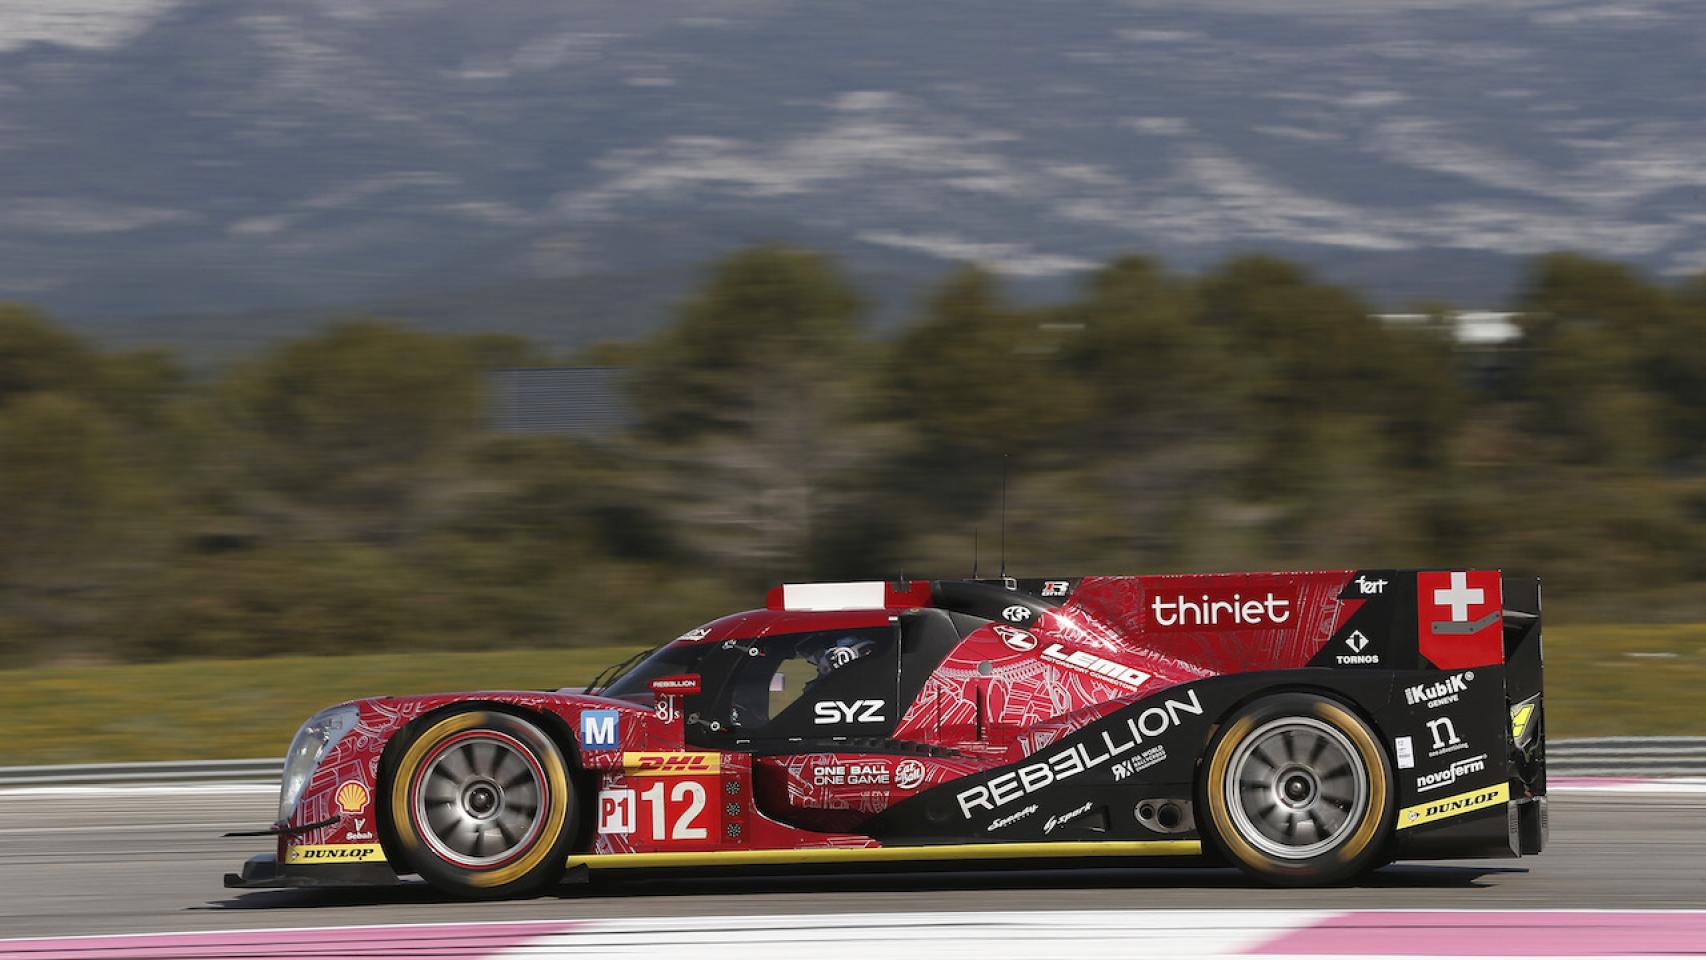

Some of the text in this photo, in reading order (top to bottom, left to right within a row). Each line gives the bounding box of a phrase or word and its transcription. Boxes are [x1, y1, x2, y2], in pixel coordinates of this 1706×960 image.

[1354, 575, 1389, 594] fert
[1151, 592, 1290, 626] thiriet
[1040, 643, 1152, 687] LEMO
[1336, 654, 1380, 665] TORNOS
[652, 680, 697, 689] REBELLION
[814, 700, 886, 725] SYZ
[584, 716, 616, 745] M
[1426, 717, 1462, 749] n
[638, 755, 711, 771] DHL
[956, 689, 1204, 820] REBELLION
[814, 765, 890, 776] ONE BALL
[814, 775, 890, 785] ONE GAME
[1416, 755, 1486, 792] novoferm
[601, 797, 629, 829] P1
[641, 780, 708, 841] 12
[1425, 791, 1499, 817] DUNLOP
[303, 848, 375, 859] DUNLOP
